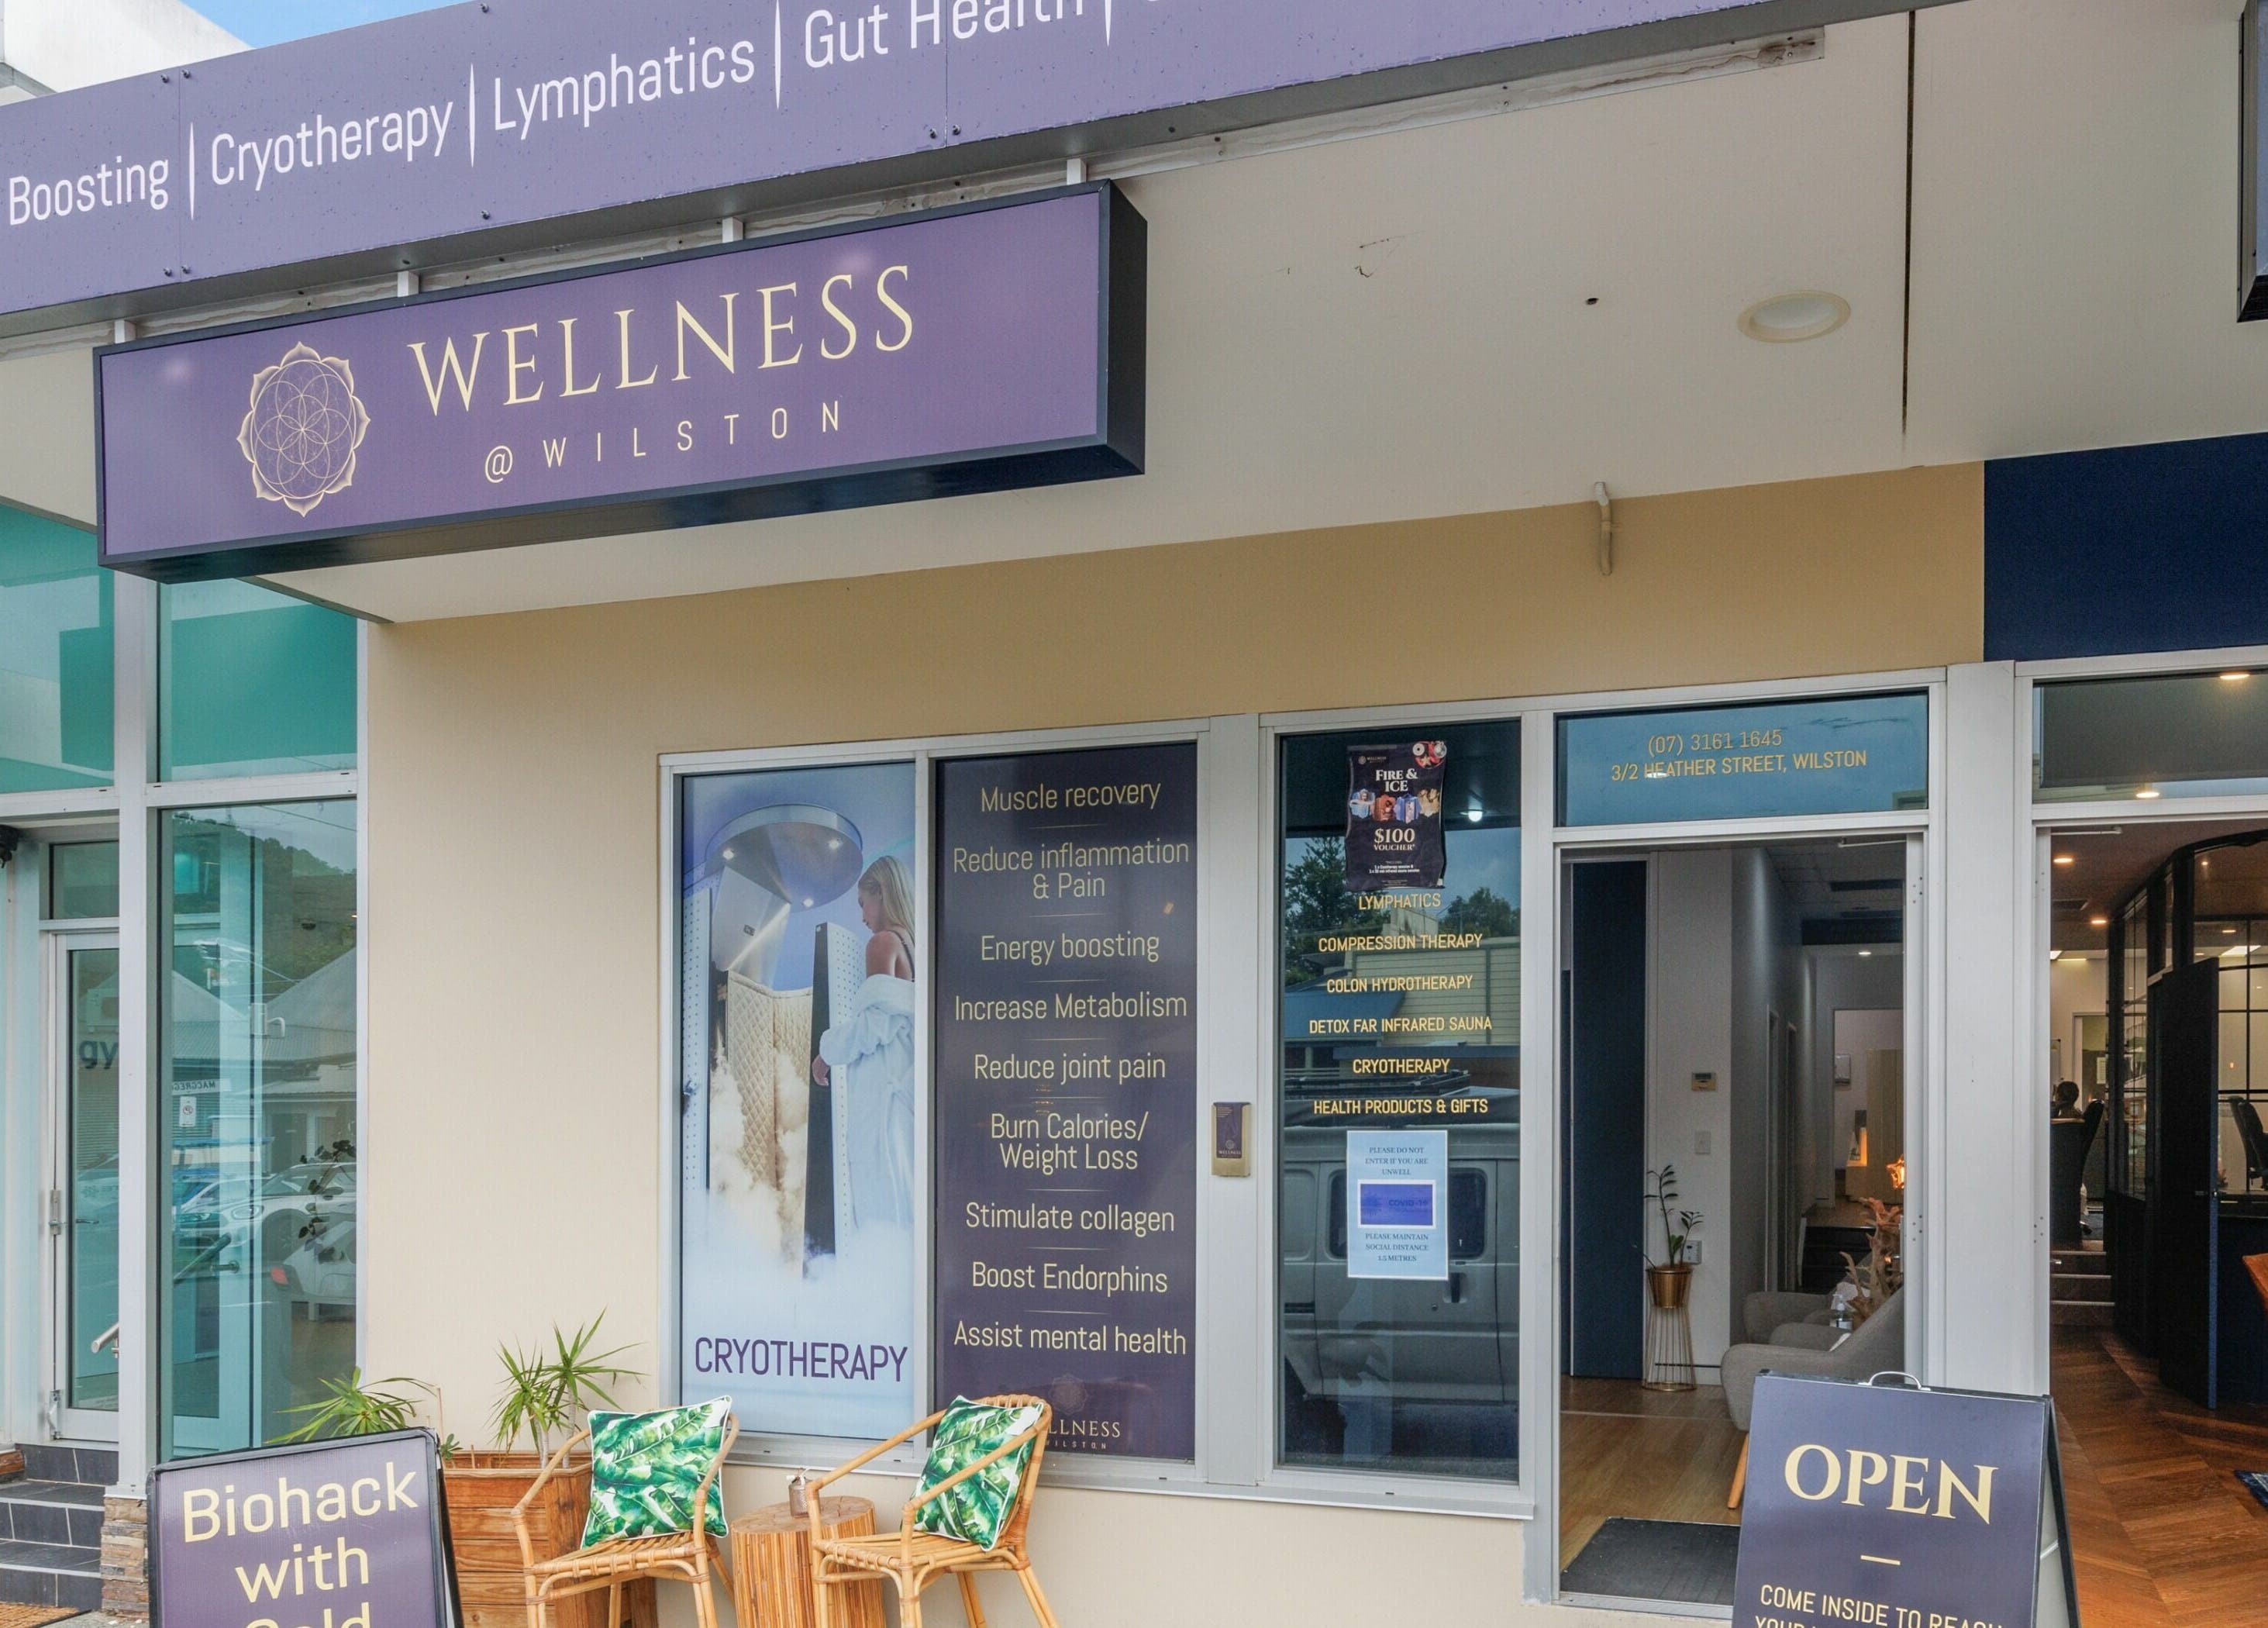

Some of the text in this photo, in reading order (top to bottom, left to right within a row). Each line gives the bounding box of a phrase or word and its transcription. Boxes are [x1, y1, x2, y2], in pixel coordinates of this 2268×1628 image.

[9, 155, 170, 226] Boosting
[211, 101, 454, 191] Cryotherapy
[494, 37, 756, 140] Lymphatics
[804, 9, 889, 68] Gut
[408, 264, 915, 416] WELLNESS
[484, 400, 839, 484] @ WILSTON
[1648, 728, 1783, 757] (07) 3161 1645
[1375, 767, 1418, 781] FIRE &
[1611, 749, 1867, 782] 3/2 HEATHER STREET, WILSTON
[981, 782, 1161, 812] Muscle recovery
[1384, 780, 1408, 793] ICE
[1374, 828, 1415, 844] $100
[953, 838, 1189, 873] Reduce inflammation
[1032, 871, 1105, 899] & Pain
[1358, 893, 1441, 910] LYMPHATICS
[981, 930, 1160, 966] Energy boosting
[1318, 933, 1484, 953] COMPRESSION THERAPY
[1327, 974, 1474, 994] COLON HYDROTHERAPY
[955, 991, 1187, 1021] Increase Metabolism
[1309, 1016, 1493, 1034] DETOX FAR INFRARED SAUNA
[974, 1052, 1166, 1085] Reduce joint pain
[1353, 1058, 1451, 1074] CRYOTHERAPY
[1314, 1099, 1488, 1115] HEALTH PRODUCTS & GIFTS
[991, 1112, 1150, 1142] Burn Calories/
[999, 1143, 1139, 1176] Weight Loss
[965, 1202, 1175, 1238] Stimulate collagen
[971, 1261, 1168, 1298] Boost Endorphins
[953, 1320, 1187, 1355] Assist mental health
[694, 1337, 908, 1382] CRYOTHERAPY
[1049, 1419, 1121, 1438] LLNESS
[1047, 1440, 1106, 1450] ILSTON
[1784, 1443, 2000, 1526] OPEN
[182, 1461, 419, 1543] Biohack
[235, 1537, 370, 1604] with
[1760, 1584, 1816, 1613] COME
[1822, 1594, 1890, 1627] INSIDE
[1895, 1606, 1922, 1628] TO
